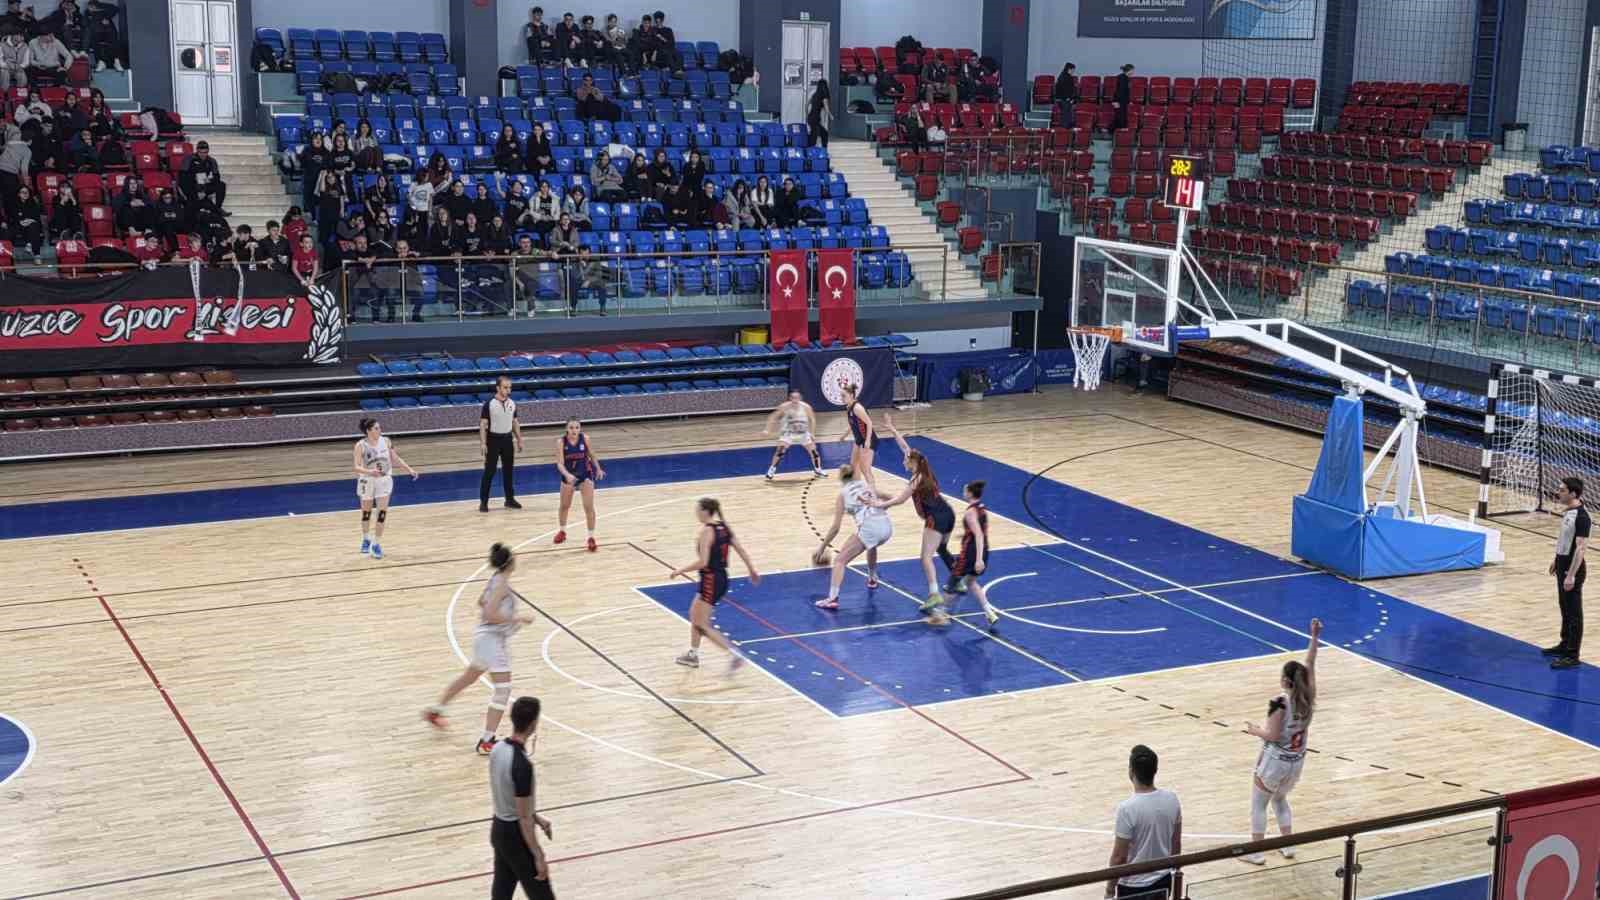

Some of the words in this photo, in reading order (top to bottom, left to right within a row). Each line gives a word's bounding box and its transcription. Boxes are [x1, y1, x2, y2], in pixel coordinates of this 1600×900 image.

[1176, 178, 1193, 205] 14
[1, 310, 82, 337] uzce
[100, 303, 186, 341] Spor
